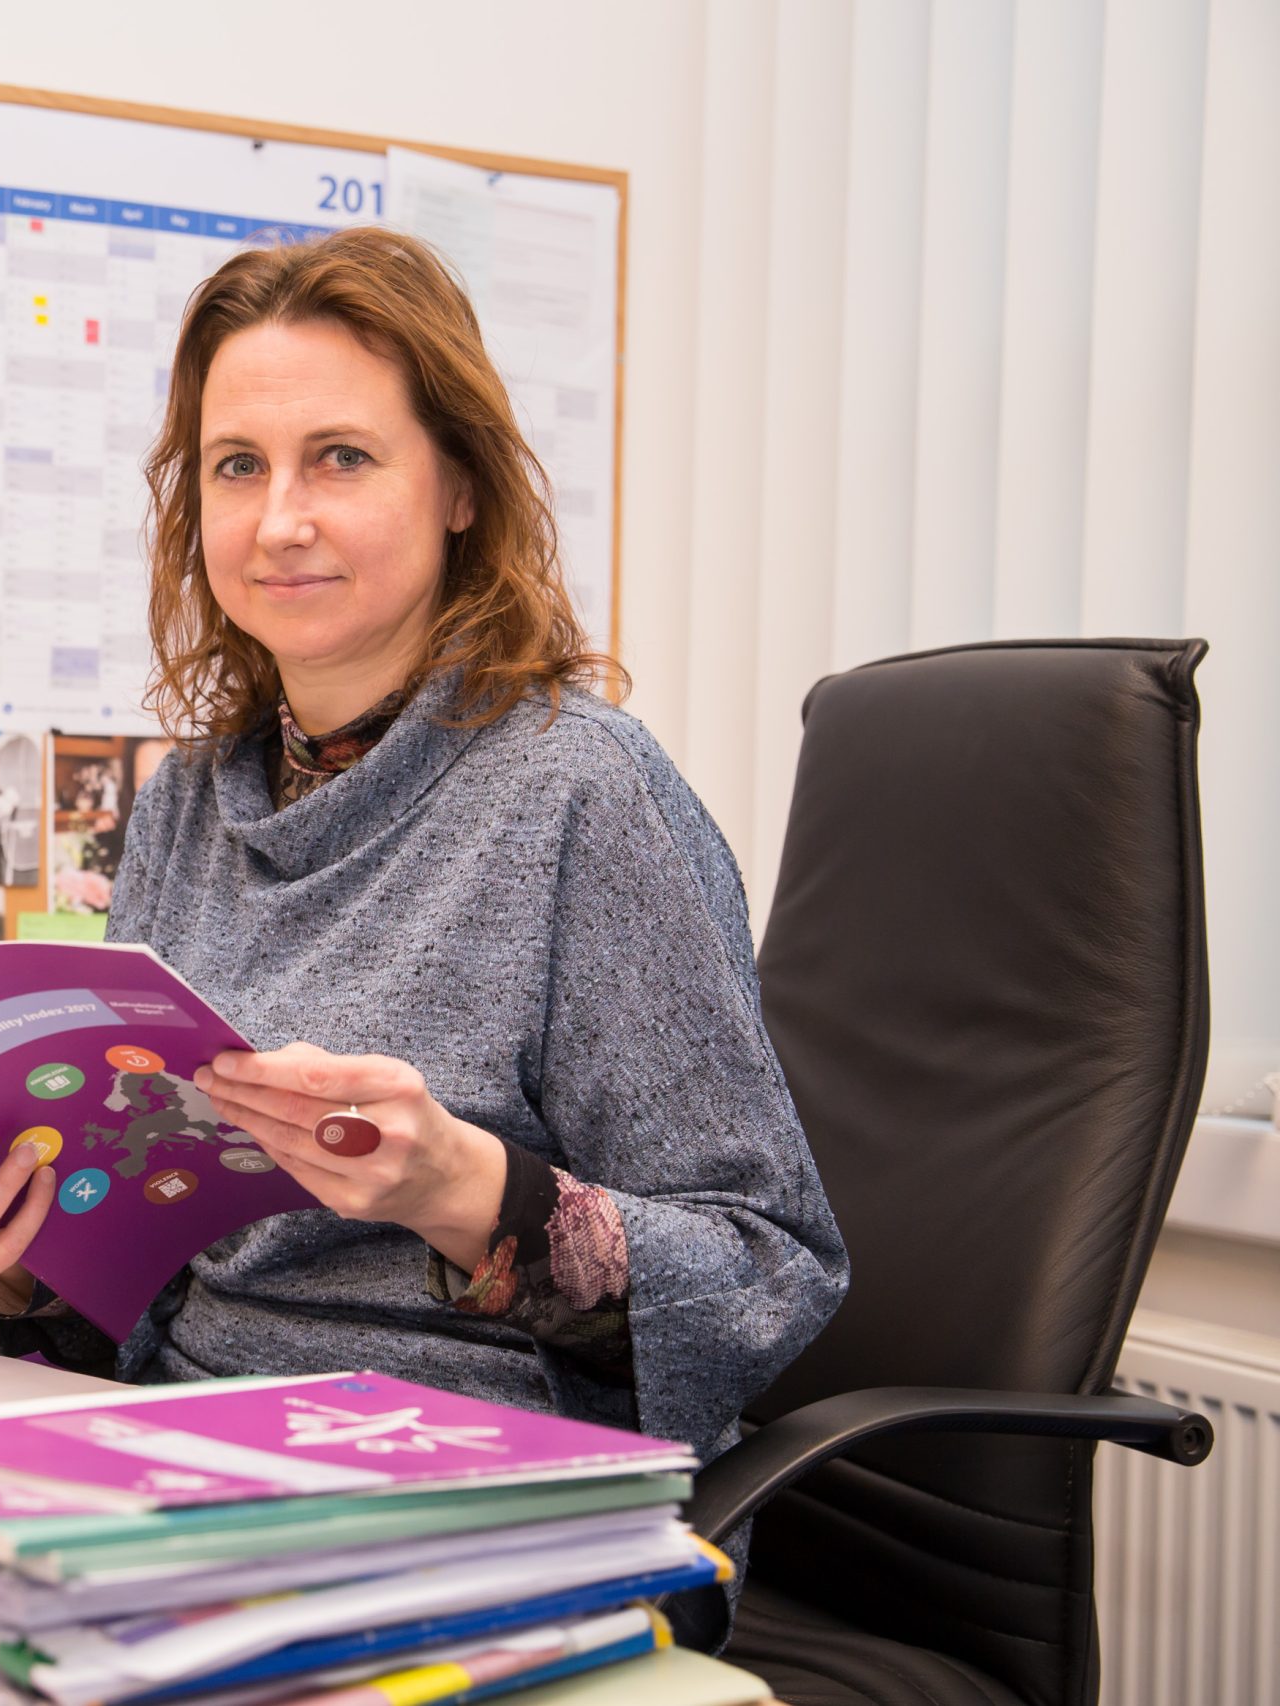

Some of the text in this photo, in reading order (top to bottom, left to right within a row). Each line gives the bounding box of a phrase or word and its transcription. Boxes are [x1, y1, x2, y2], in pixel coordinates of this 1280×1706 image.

[318, 175, 383, 216] 201
[23, 1005, 65, 1025] Index
[66, 1002, 97, 1015] 2017
[68, 1176, 88, 1193] WORK
[148, 1171, 179, 1189] VIOLENCE
